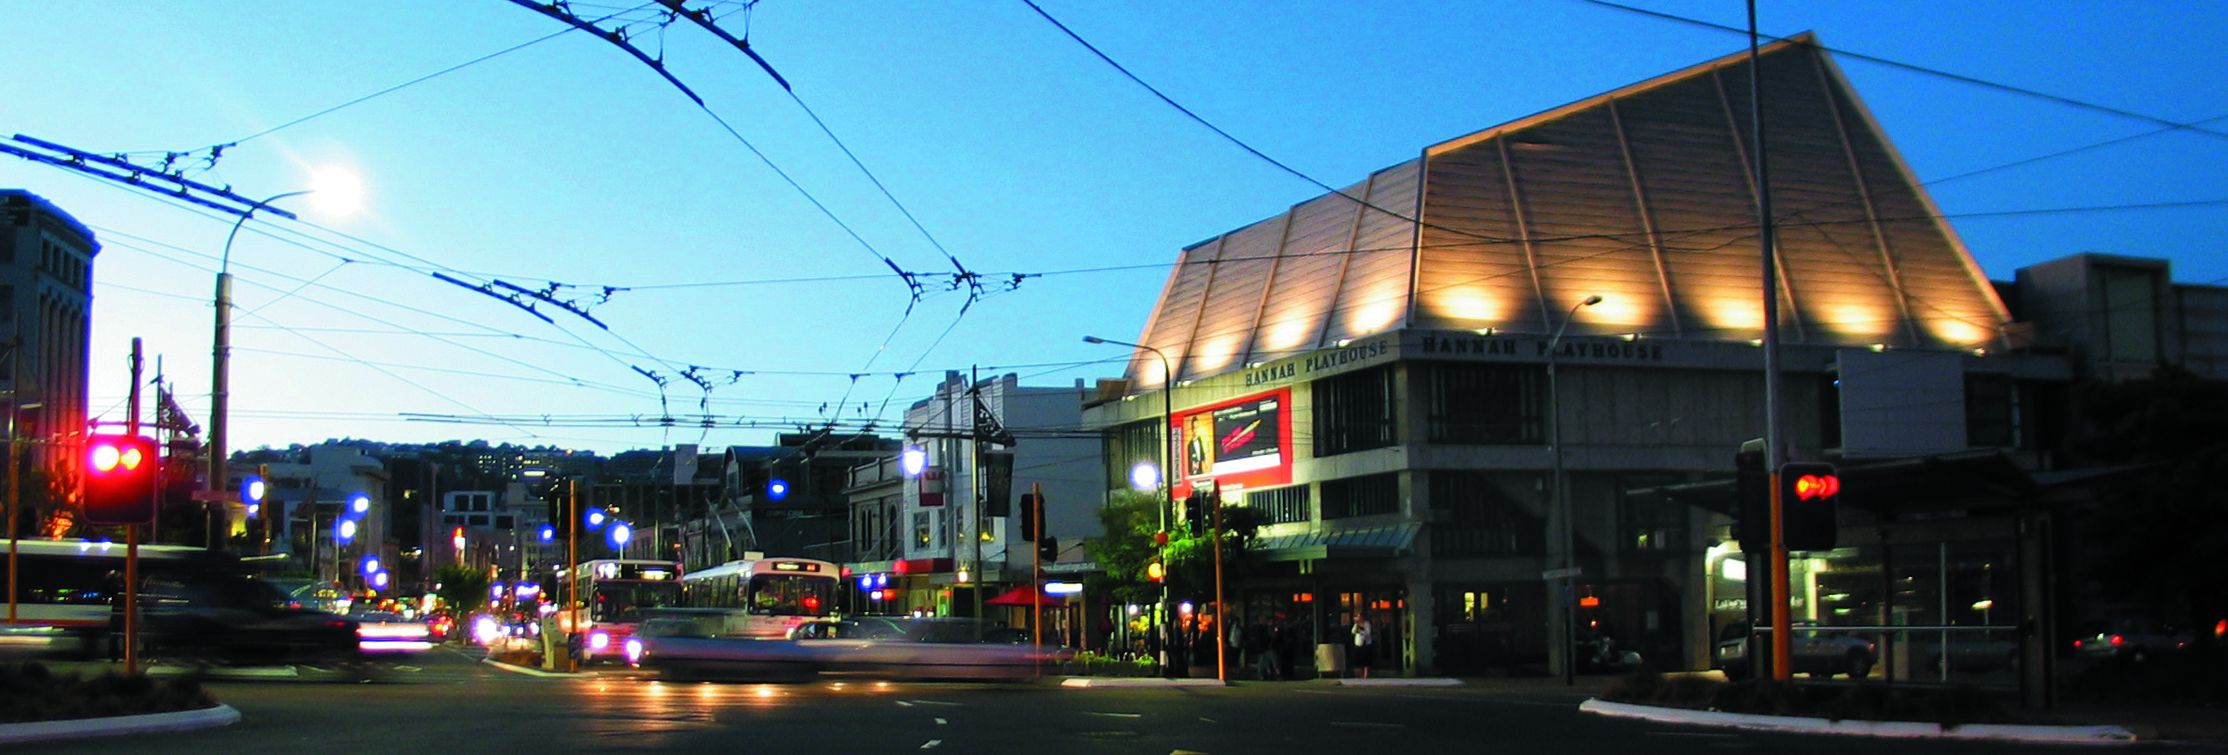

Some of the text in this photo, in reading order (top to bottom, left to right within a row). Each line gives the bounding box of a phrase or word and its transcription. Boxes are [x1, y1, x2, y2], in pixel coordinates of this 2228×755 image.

[1246, 341, 1388, 387] HANNAH PLAYHOUSE
[1423, 336, 1663, 359] HANNAH PLAYHOUSE
